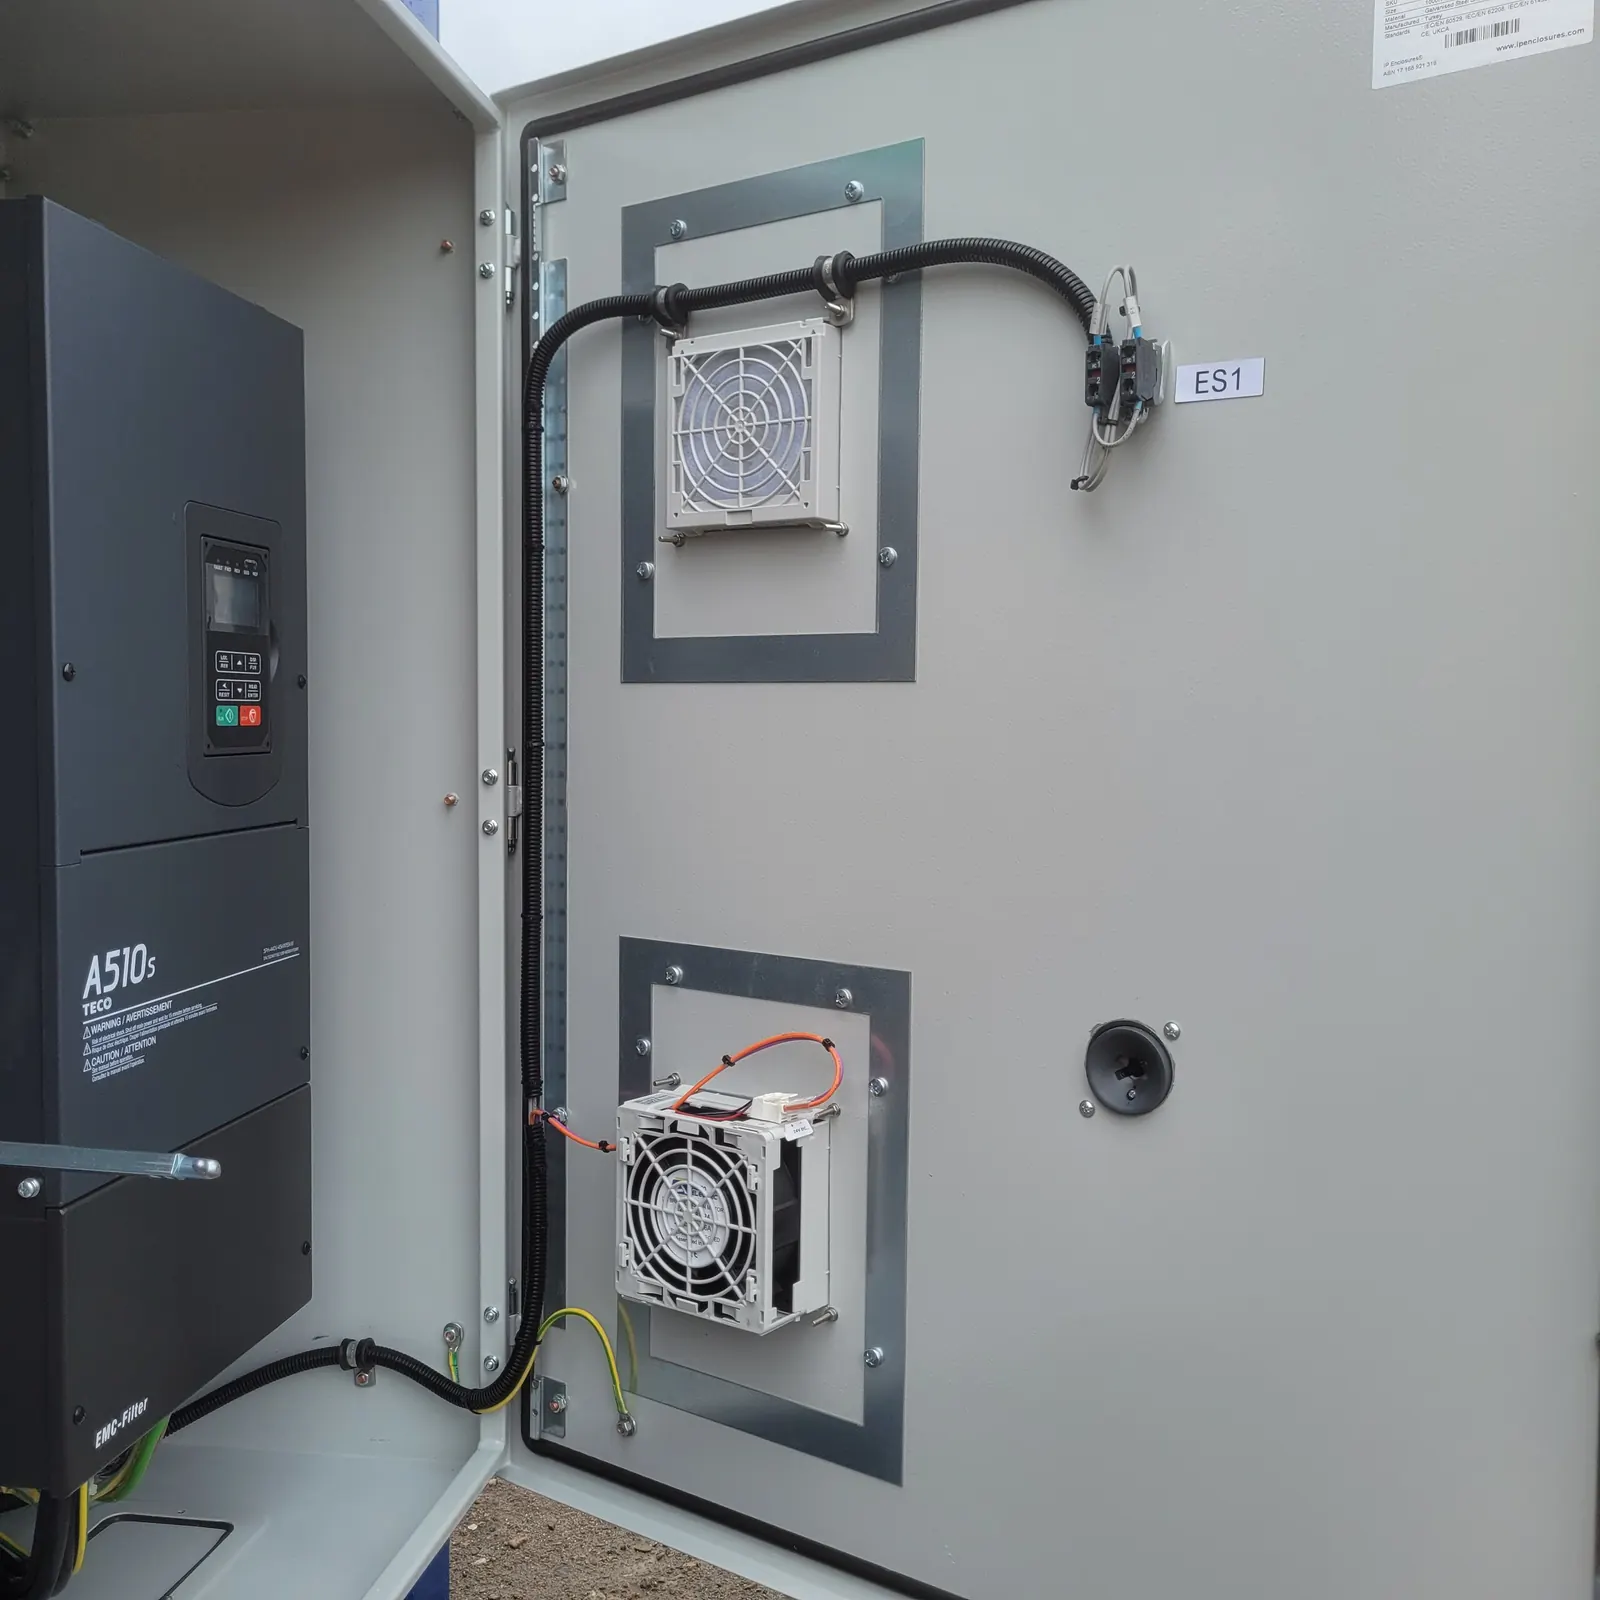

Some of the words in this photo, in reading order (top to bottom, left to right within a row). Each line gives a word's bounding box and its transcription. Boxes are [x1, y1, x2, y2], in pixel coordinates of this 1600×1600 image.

[1384, 18, 1420, 31] Manufactured
[1385, 14, 1406, 23] Material
[1384, 29, 1411, 39] Standards
[1495, 28, 1585, 52] www.ipenclosures.com
[1195, 366, 1241, 395] ES1
[82, 996, 113, 1017] TECO
[90, 1016, 122, 1035] WARNING
[125, 1000, 173, 1023] AVERTISSEMENT
[91, 1048, 120, 1067] CAUTION
[124, 1035, 157, 1056] ATTENTION
[95, 1396, 149, 1449] EMC-Filter
